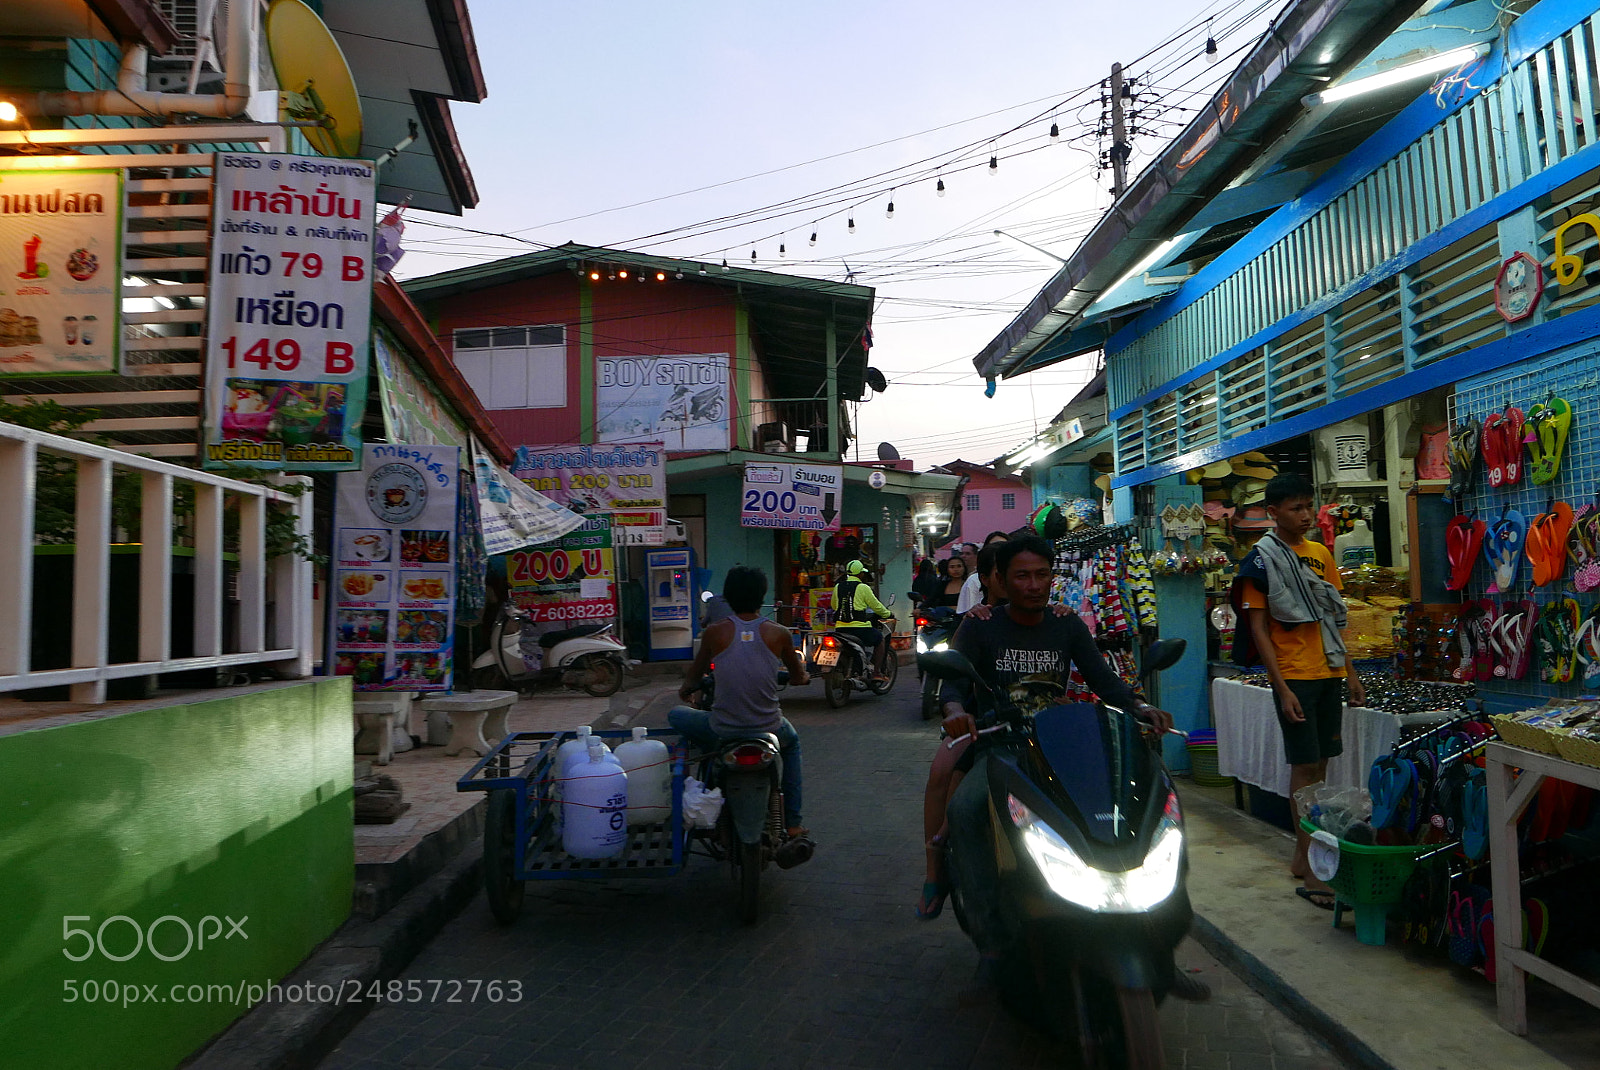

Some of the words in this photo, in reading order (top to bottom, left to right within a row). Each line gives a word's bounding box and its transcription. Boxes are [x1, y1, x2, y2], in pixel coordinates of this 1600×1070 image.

[268, 159, 282, 170] @
[232, 183, 362, 220] เหล้าปั่น
[285, 226, 299, 237] &
[220, 245, 271, 276] แก้ว
[281, 251, 323, 279] 79
[341, 255, 365, 282] B
[235, 290, 344, 330] เหยือก
[221, 336, 301, 371] 149
[324, 341, 355, 374] B
[795, 468, 836, 484] ร้านบอย
[1489, 467, 1502, 486] 19
[1507, 463, 1517, 480] 19
[569, 473, 611, 490] 200
[617, 474, 653, 488] บาท
[743, 489, 797, 514] 200
[799, 505, 818, 515] บาท
[512, 549, 570, 581] 200
[581, 548, 610, 577] บ.
[1003, 648, 1059, 662] AVENGED
